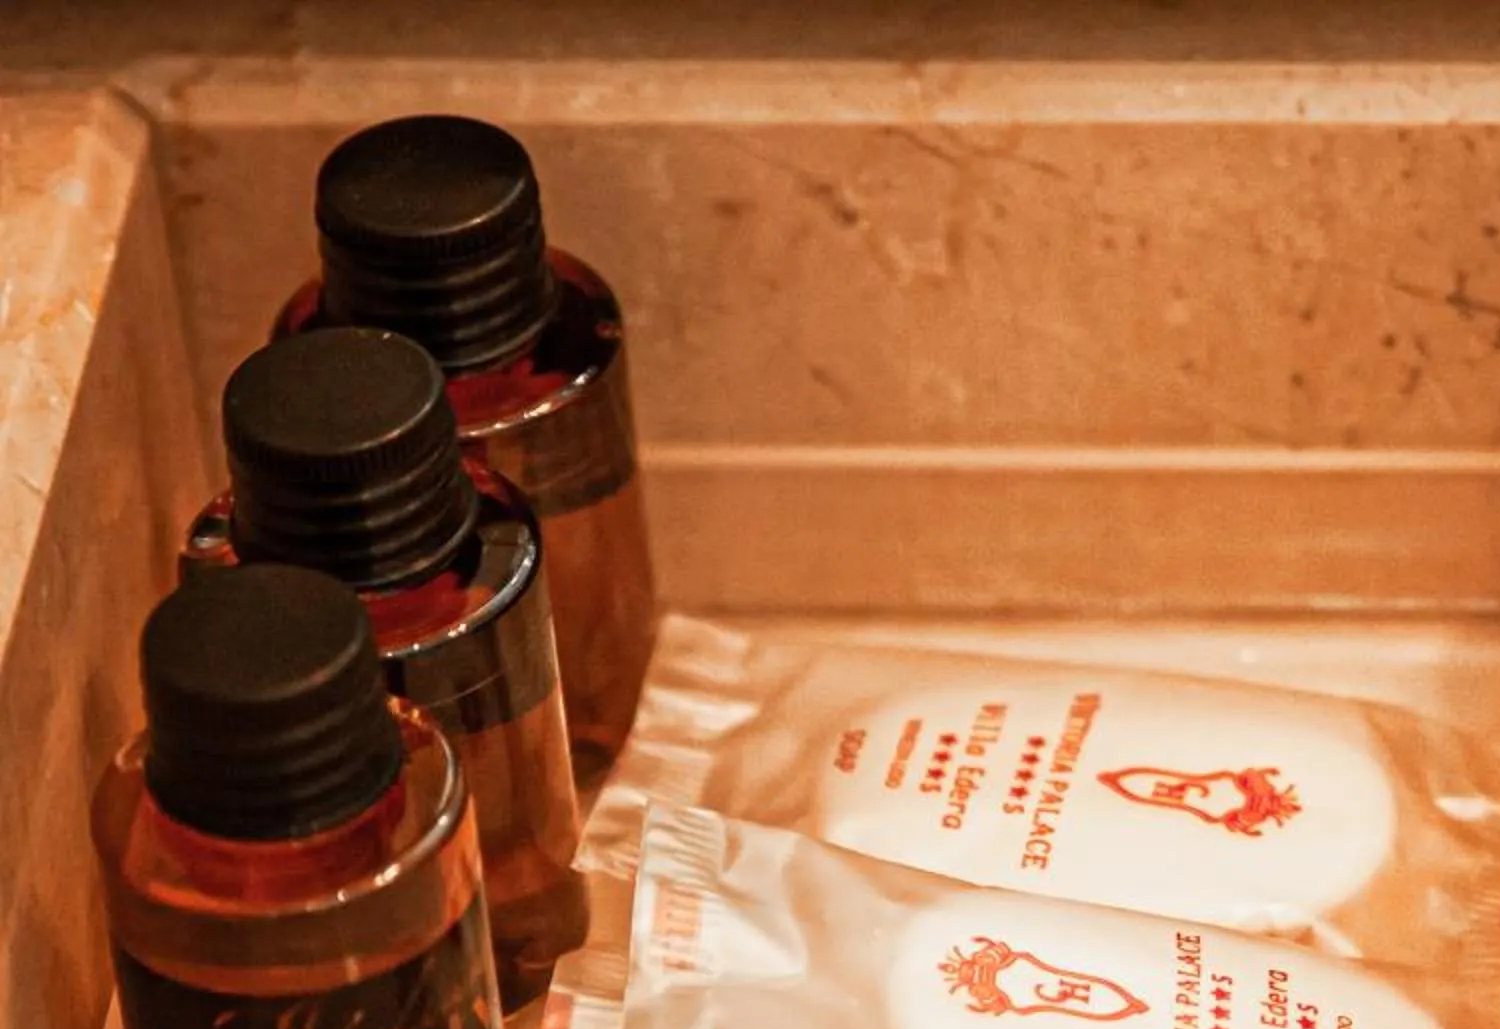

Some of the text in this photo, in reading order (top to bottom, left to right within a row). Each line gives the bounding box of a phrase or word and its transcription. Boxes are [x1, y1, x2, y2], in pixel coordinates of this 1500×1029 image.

[940, 764, 986, 831] Edera
[1020, 779, 1070, 871] PALACE
[1174, 930, 1202, 1008] PALACE
[1260, 968, 1290, 1029] Edera
